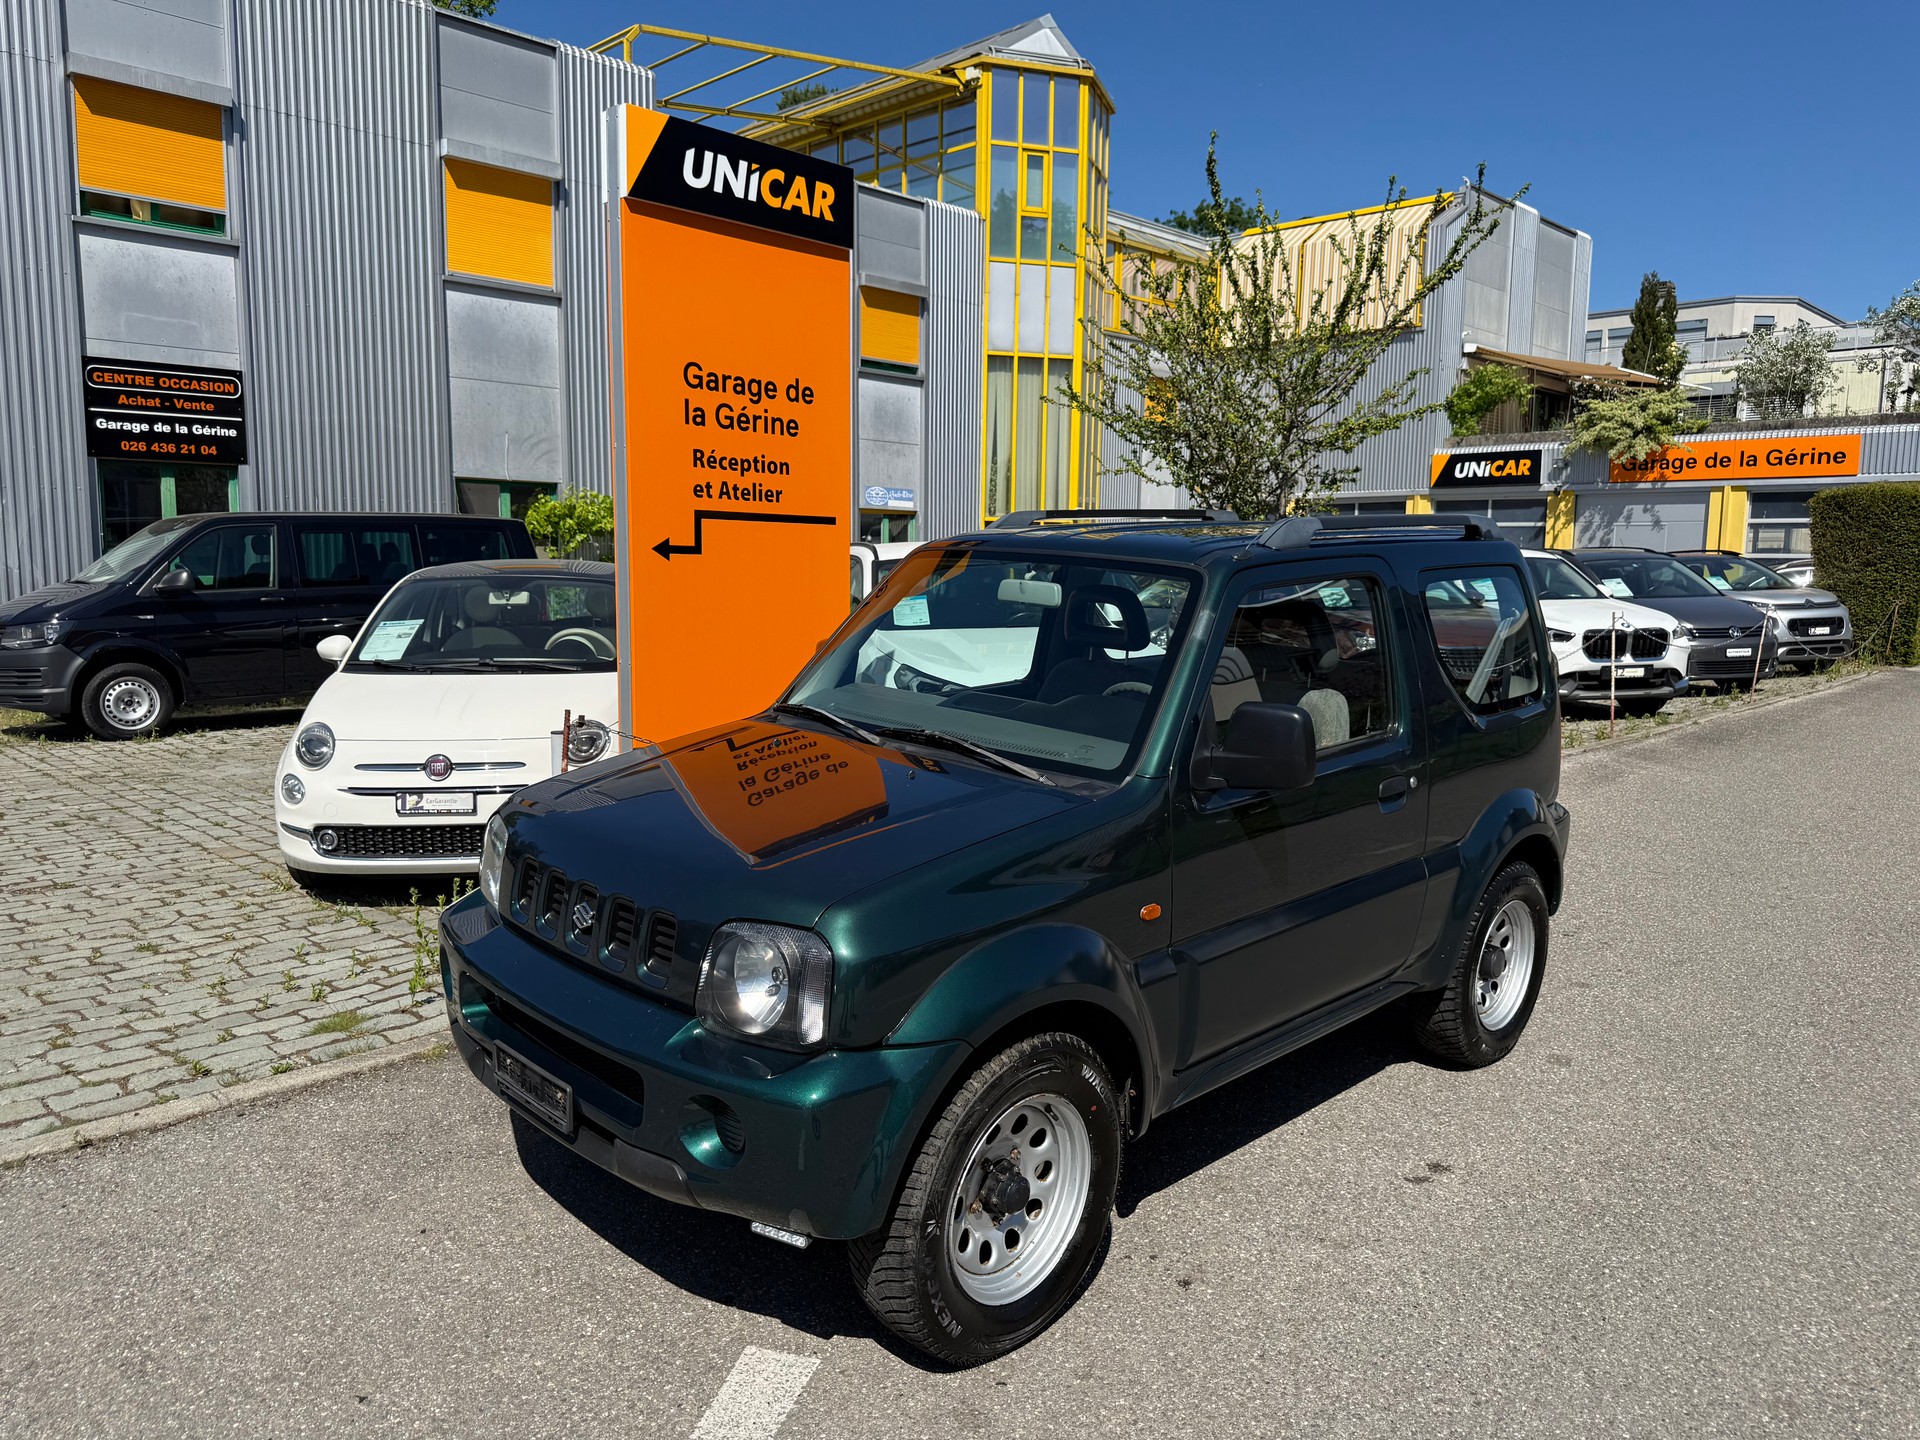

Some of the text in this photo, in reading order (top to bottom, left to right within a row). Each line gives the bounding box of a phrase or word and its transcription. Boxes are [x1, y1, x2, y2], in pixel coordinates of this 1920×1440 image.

[92, 371, 235, 394] CENTRE OCCASION
[683, 361, 815, 405] Garage de
[117, 394, 161, 407] Achat
[173, 398, 215, 411] Vente
[95, 418, 238, 438] Garage de la Gérine
[684, 398, 799, 437] la Gérine
[120, 440, 217, 456] 026 436 21 04
[692, 448, 790, 477] Réception
[1621, 447, 1847, 474] Garage de la Gérine
[693, 480, 783, 503] et Atelier
[430, 762, 446, 774] FIAT
